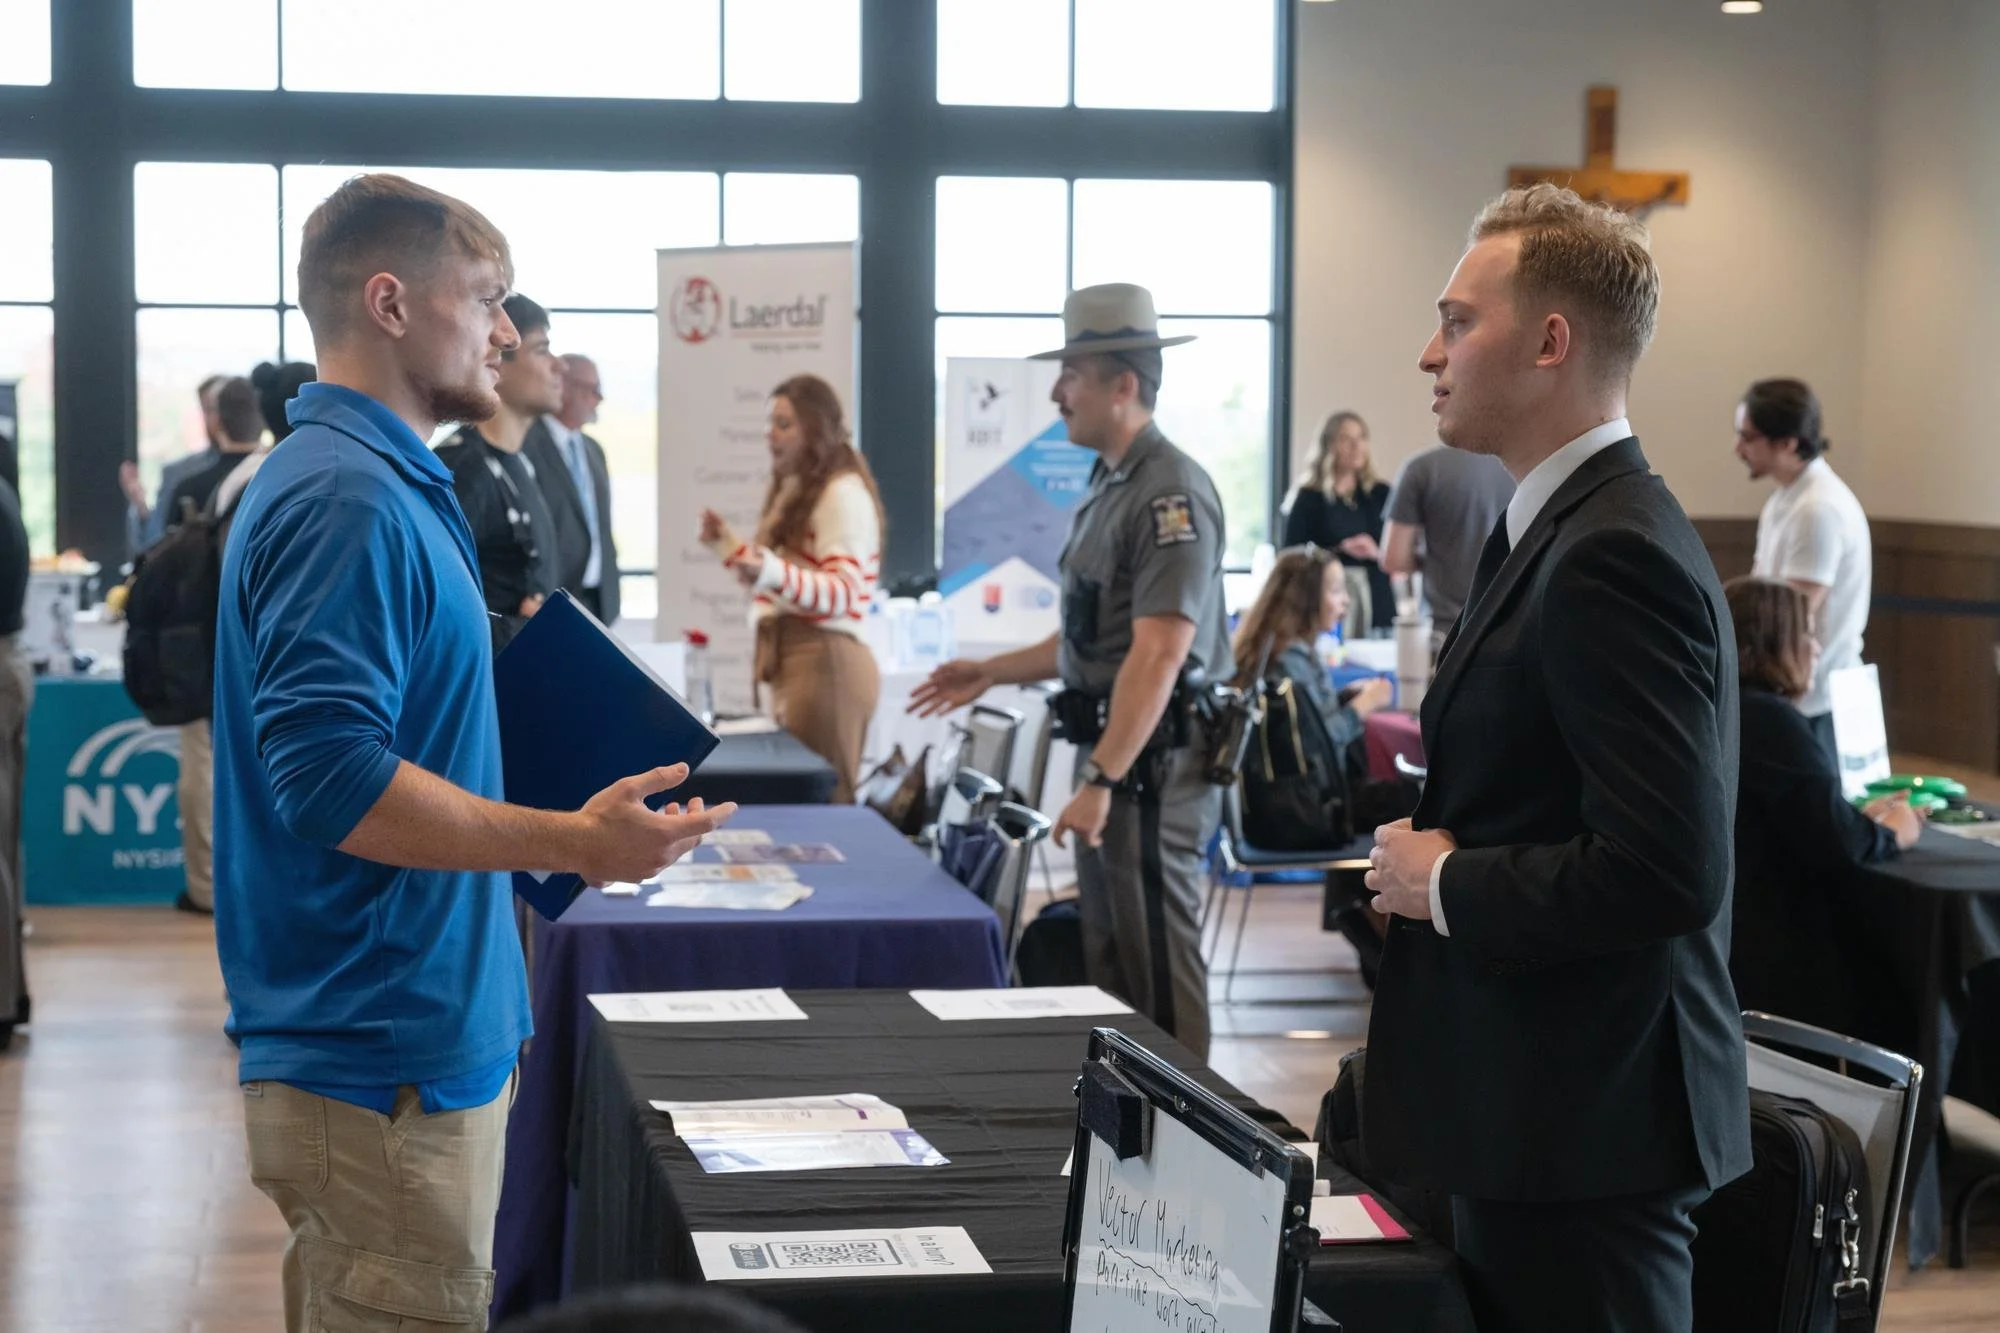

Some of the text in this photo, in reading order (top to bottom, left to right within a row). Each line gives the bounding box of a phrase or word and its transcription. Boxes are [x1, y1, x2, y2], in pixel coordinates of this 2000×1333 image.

[729, 294, 826, 330] Laerdal
[1099, 1158, 1147, 1249] Vector
[922, 1246, 955, 1266] hurry?
